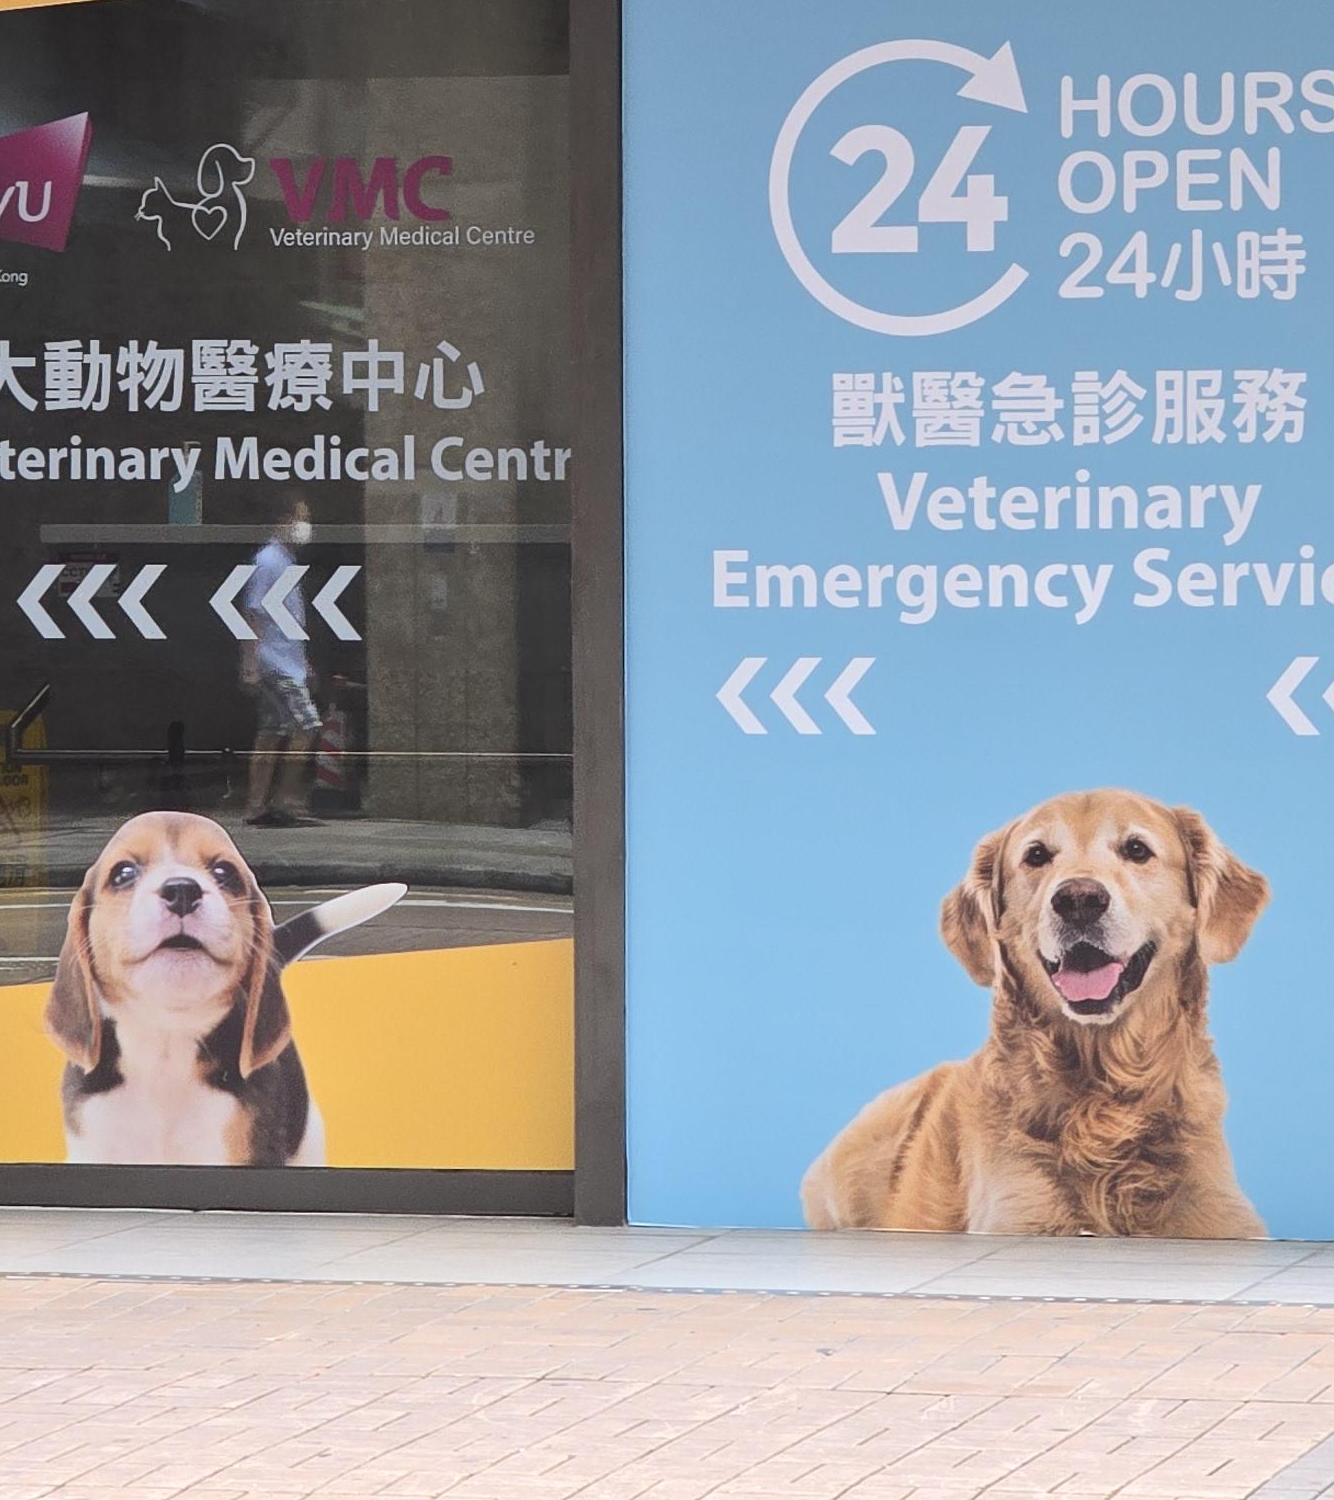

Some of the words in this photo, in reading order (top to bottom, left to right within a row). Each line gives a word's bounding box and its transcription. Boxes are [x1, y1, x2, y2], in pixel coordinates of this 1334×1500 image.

[269, 156, 451, 223] VMC
[829, 124, 1009, 254] 24
[1058, 146, 1281, 214] OPEN
[269, 226, 374, 251] Veterinary
[379, 225, 460, 246] Medical
[466, 225, 535, 246] Centre
[1058, 227, 1307, 302] 24小時
[831, 367, 1308, 448] 獸醫急診服務
[214, 434, 416, 482] Medical
[876, 468, 1263, 546] Veterinary
[712, 549, 1114, 626] Emergency
